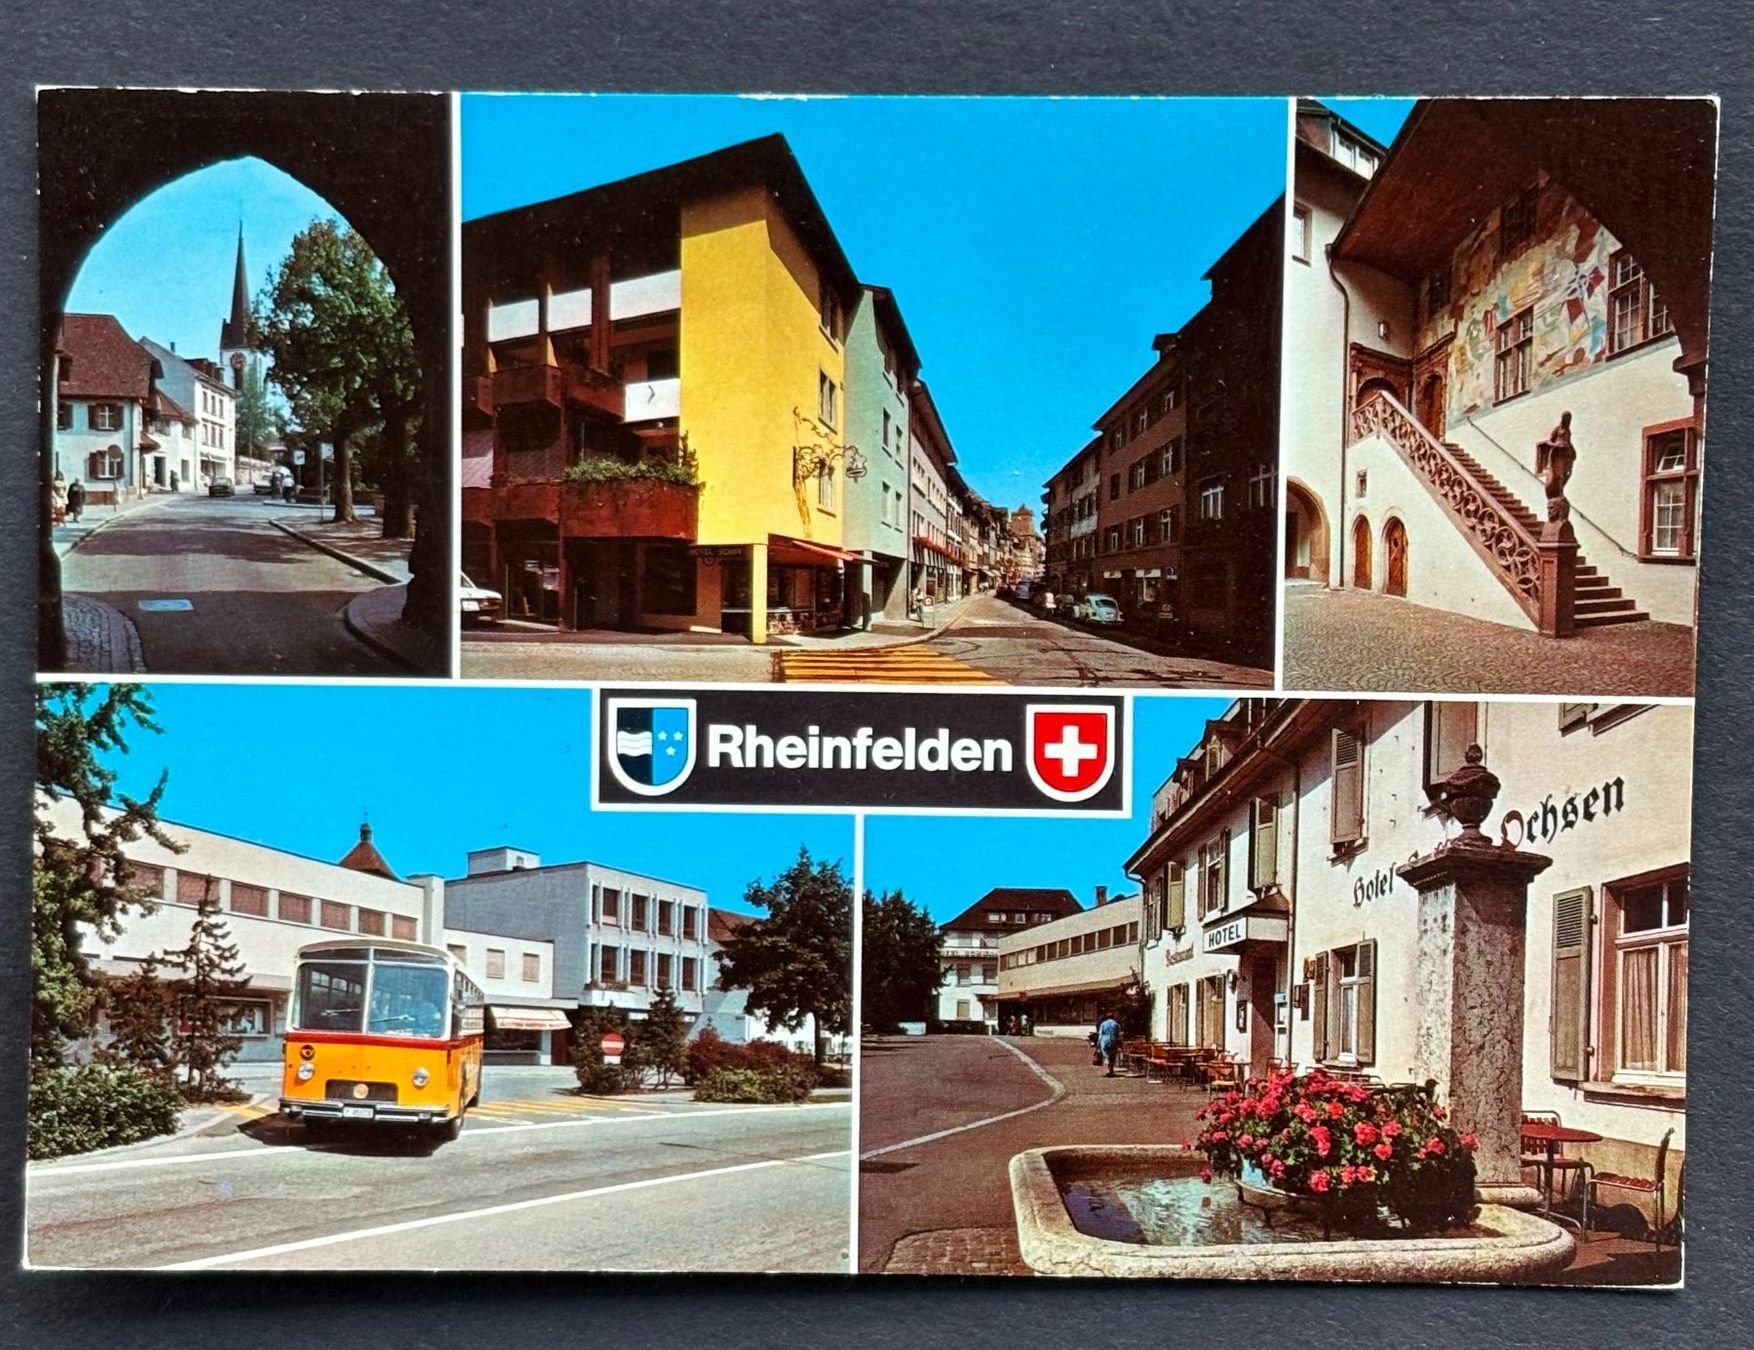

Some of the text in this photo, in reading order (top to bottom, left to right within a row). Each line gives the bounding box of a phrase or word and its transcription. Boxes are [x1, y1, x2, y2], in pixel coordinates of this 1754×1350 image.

[708, 724, 1013, 771] Rheinfelden
[1353, 776, 1625, 909] Hotel Ochsen
[1208, 923, 1241, 948] HOTEL
